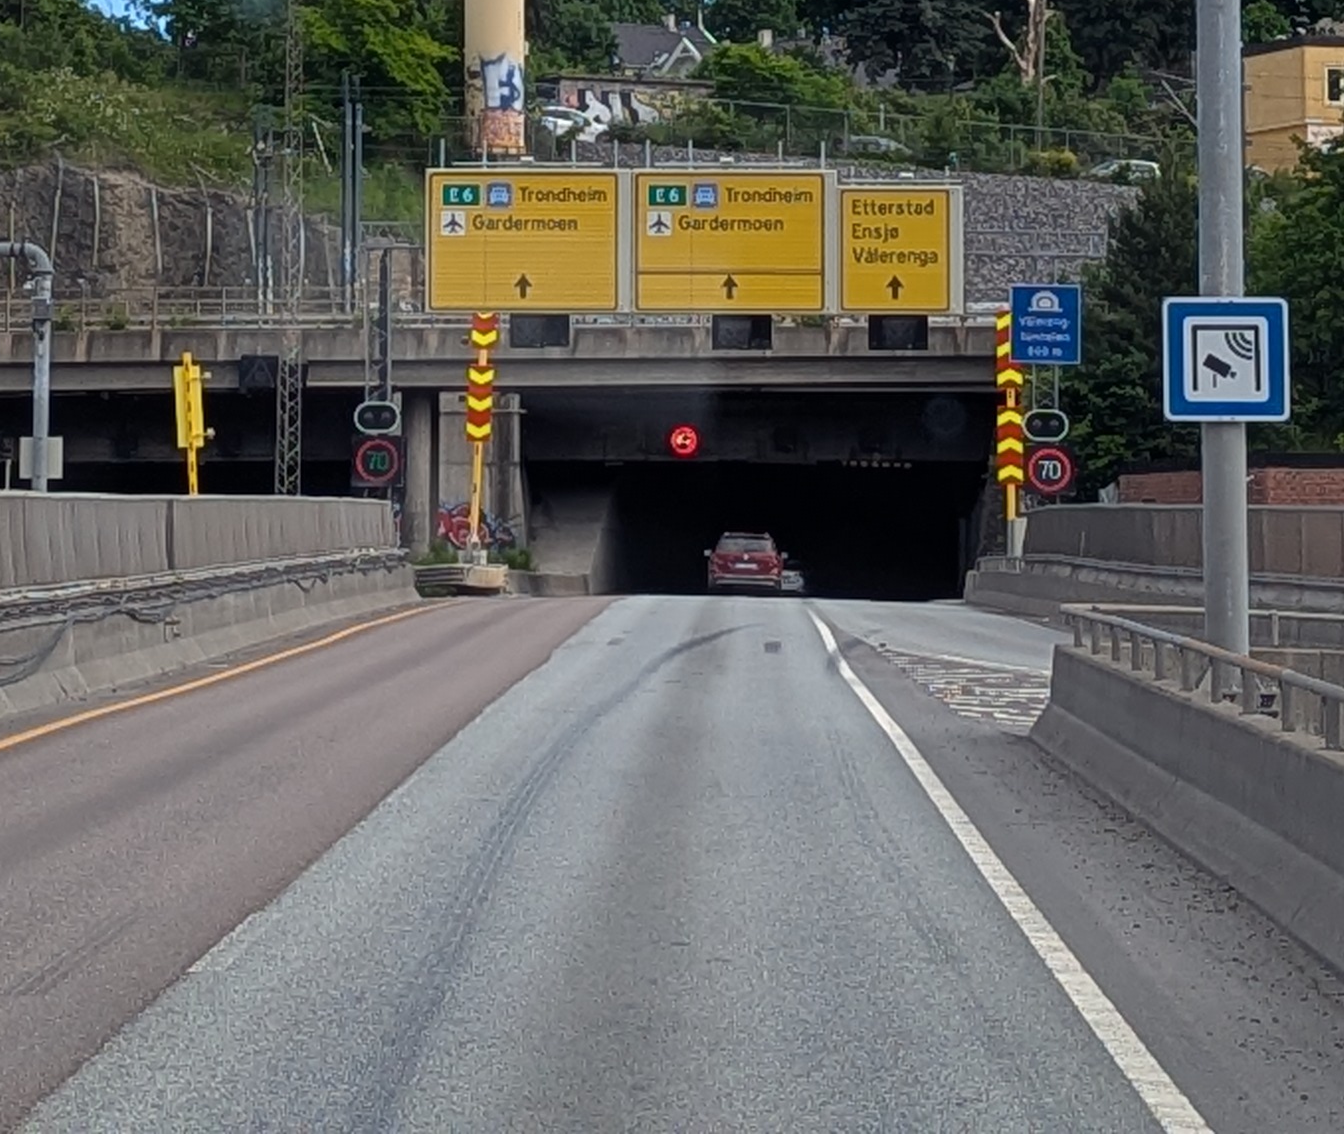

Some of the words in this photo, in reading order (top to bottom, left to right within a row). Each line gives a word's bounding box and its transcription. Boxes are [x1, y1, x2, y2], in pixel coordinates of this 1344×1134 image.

[519, 186, 607, 203] Trondheim
[725, 186, 813, 204] Trondheim
[851, 198, 936, 216] Etterstad
[472, 213, 579, 232] Gardermoen
[678, 213, 785, 232] Gardermoen
[851, 222, 900, 244] Ensjø
[852, 247, 940, 268] Vålerenga
[366, 450, 389, 471] 70
[1038, 460, 1062, 480] 70
